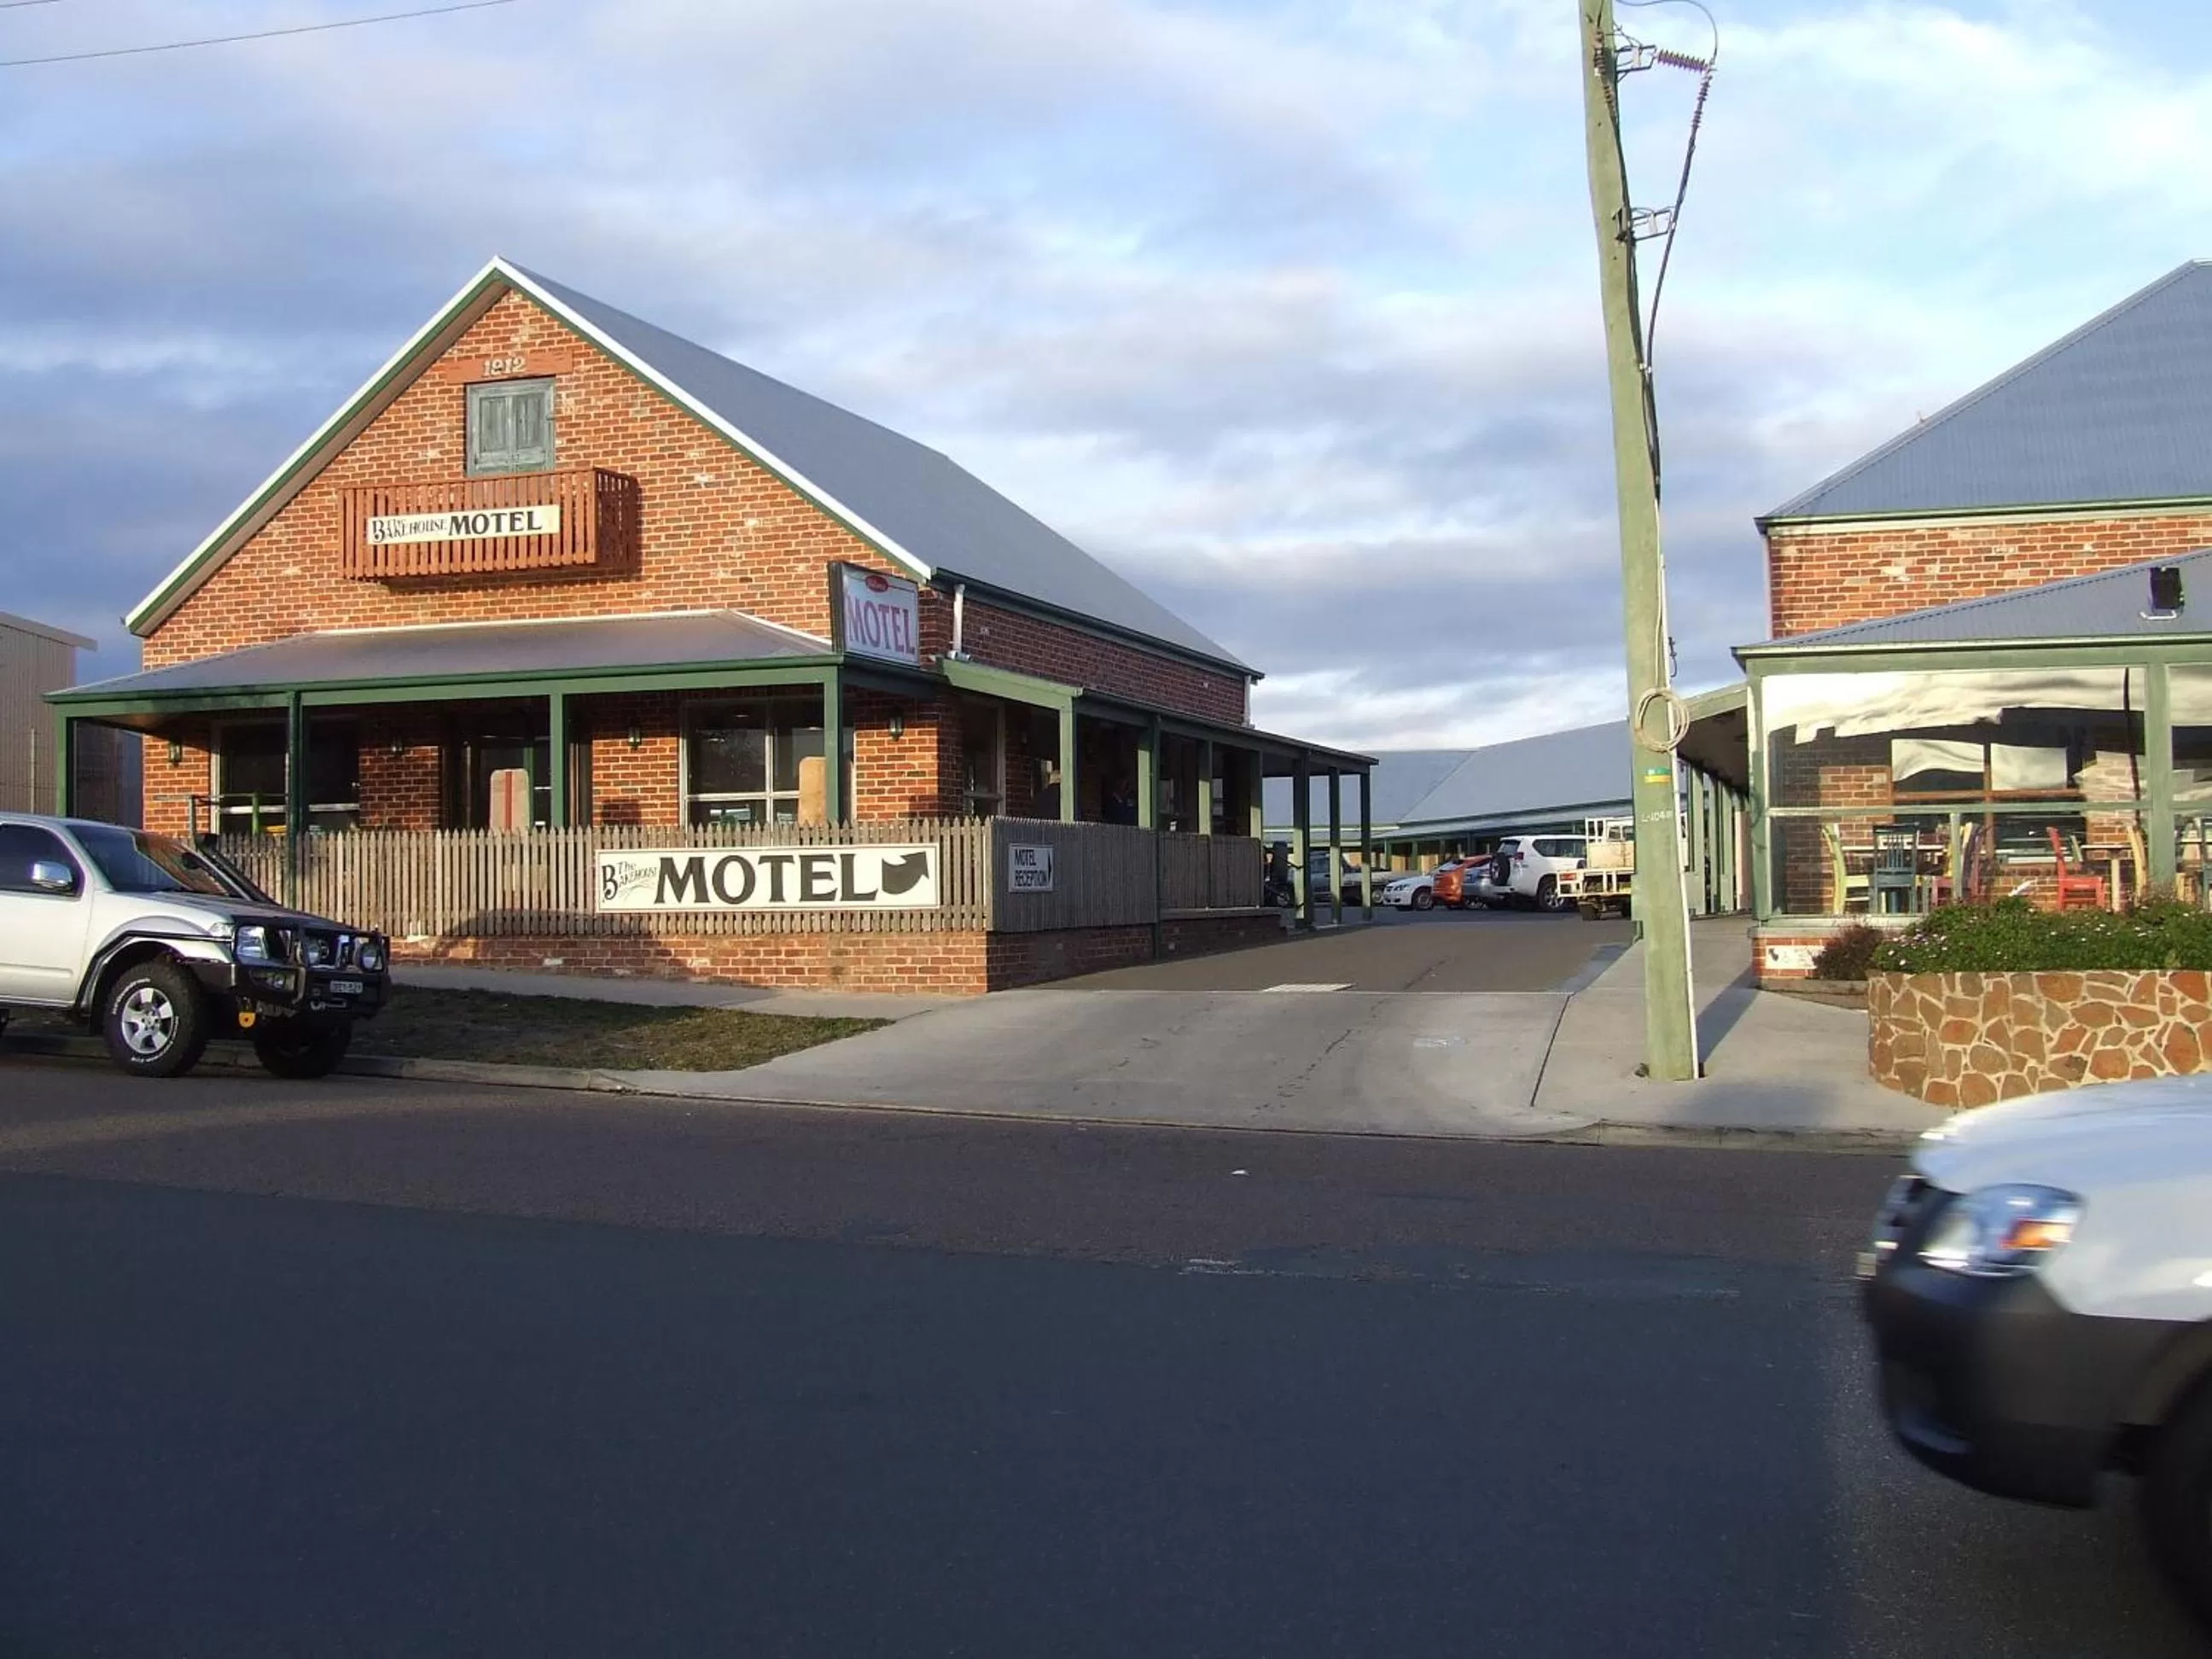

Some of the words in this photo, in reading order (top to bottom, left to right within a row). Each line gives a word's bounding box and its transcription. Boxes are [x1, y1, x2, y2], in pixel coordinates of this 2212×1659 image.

[482, 356, 527, 376] 1912
[448, 510, 543, 536] MOTEL
[845, 594, 916, 655] MOTEL
[1014, 848, 1037, 866] MOTEL
[654, 853, 879, 904] MOTEL
